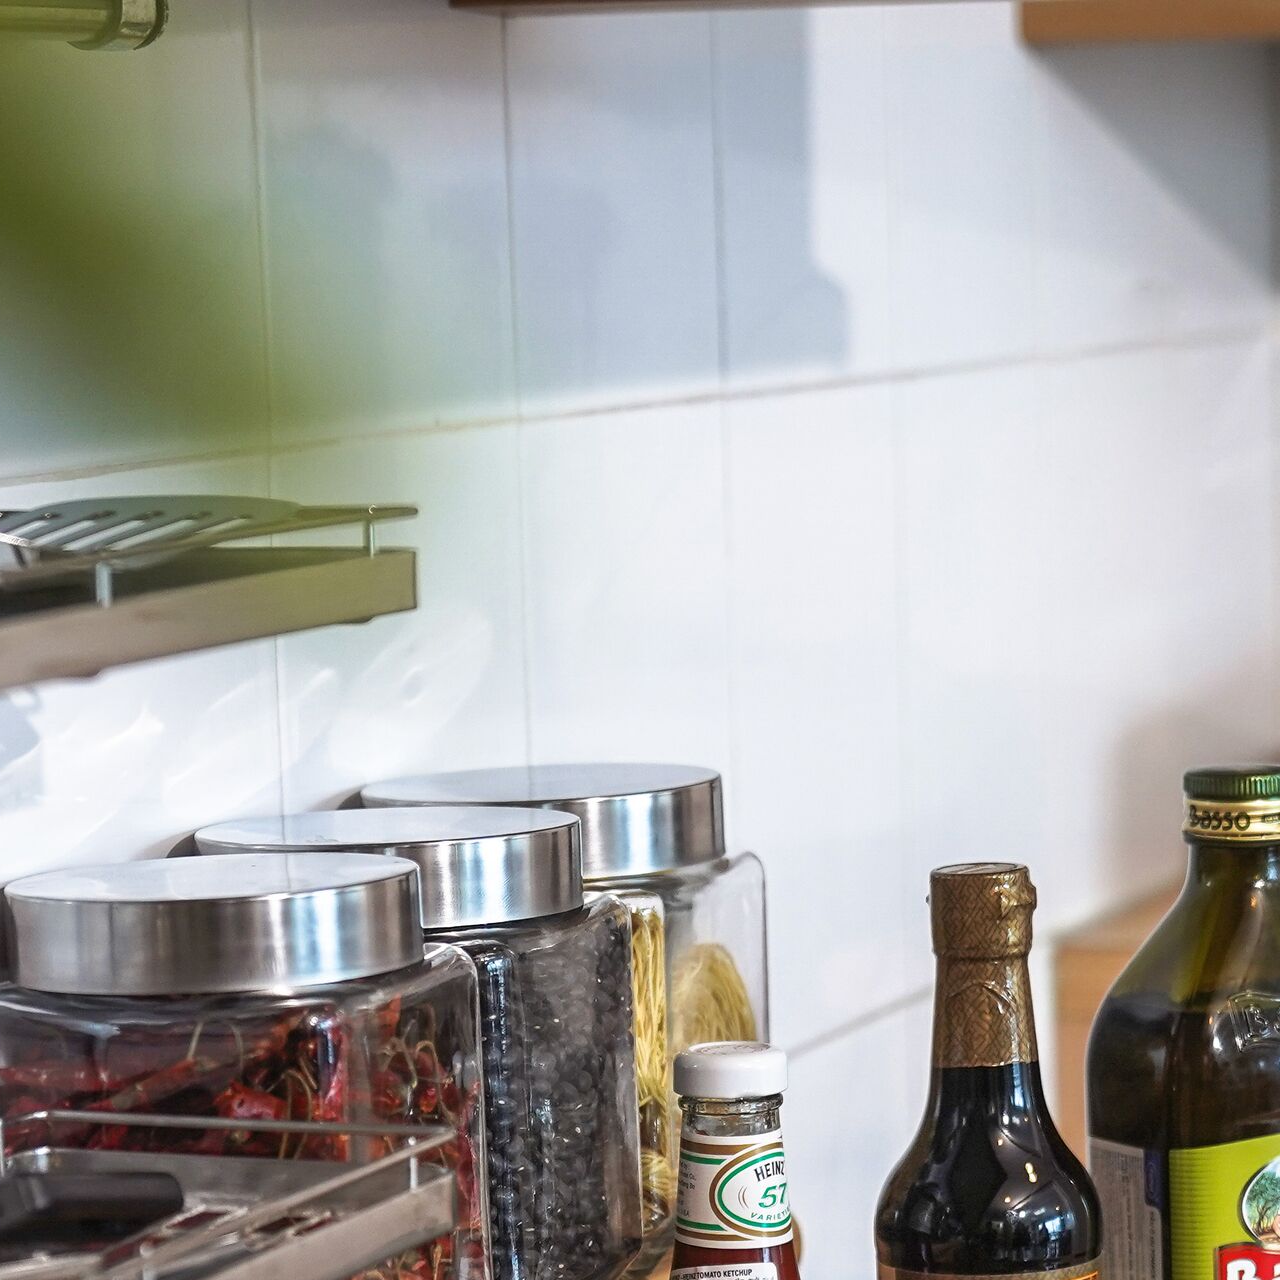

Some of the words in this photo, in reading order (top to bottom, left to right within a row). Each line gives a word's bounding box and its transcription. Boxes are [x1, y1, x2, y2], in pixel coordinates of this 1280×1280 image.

[754, 1160, 786, 1182] HEINZ
[758, 1183, 787, 1208] 57
[722, 1268, 753, 1278] KETCHUP
